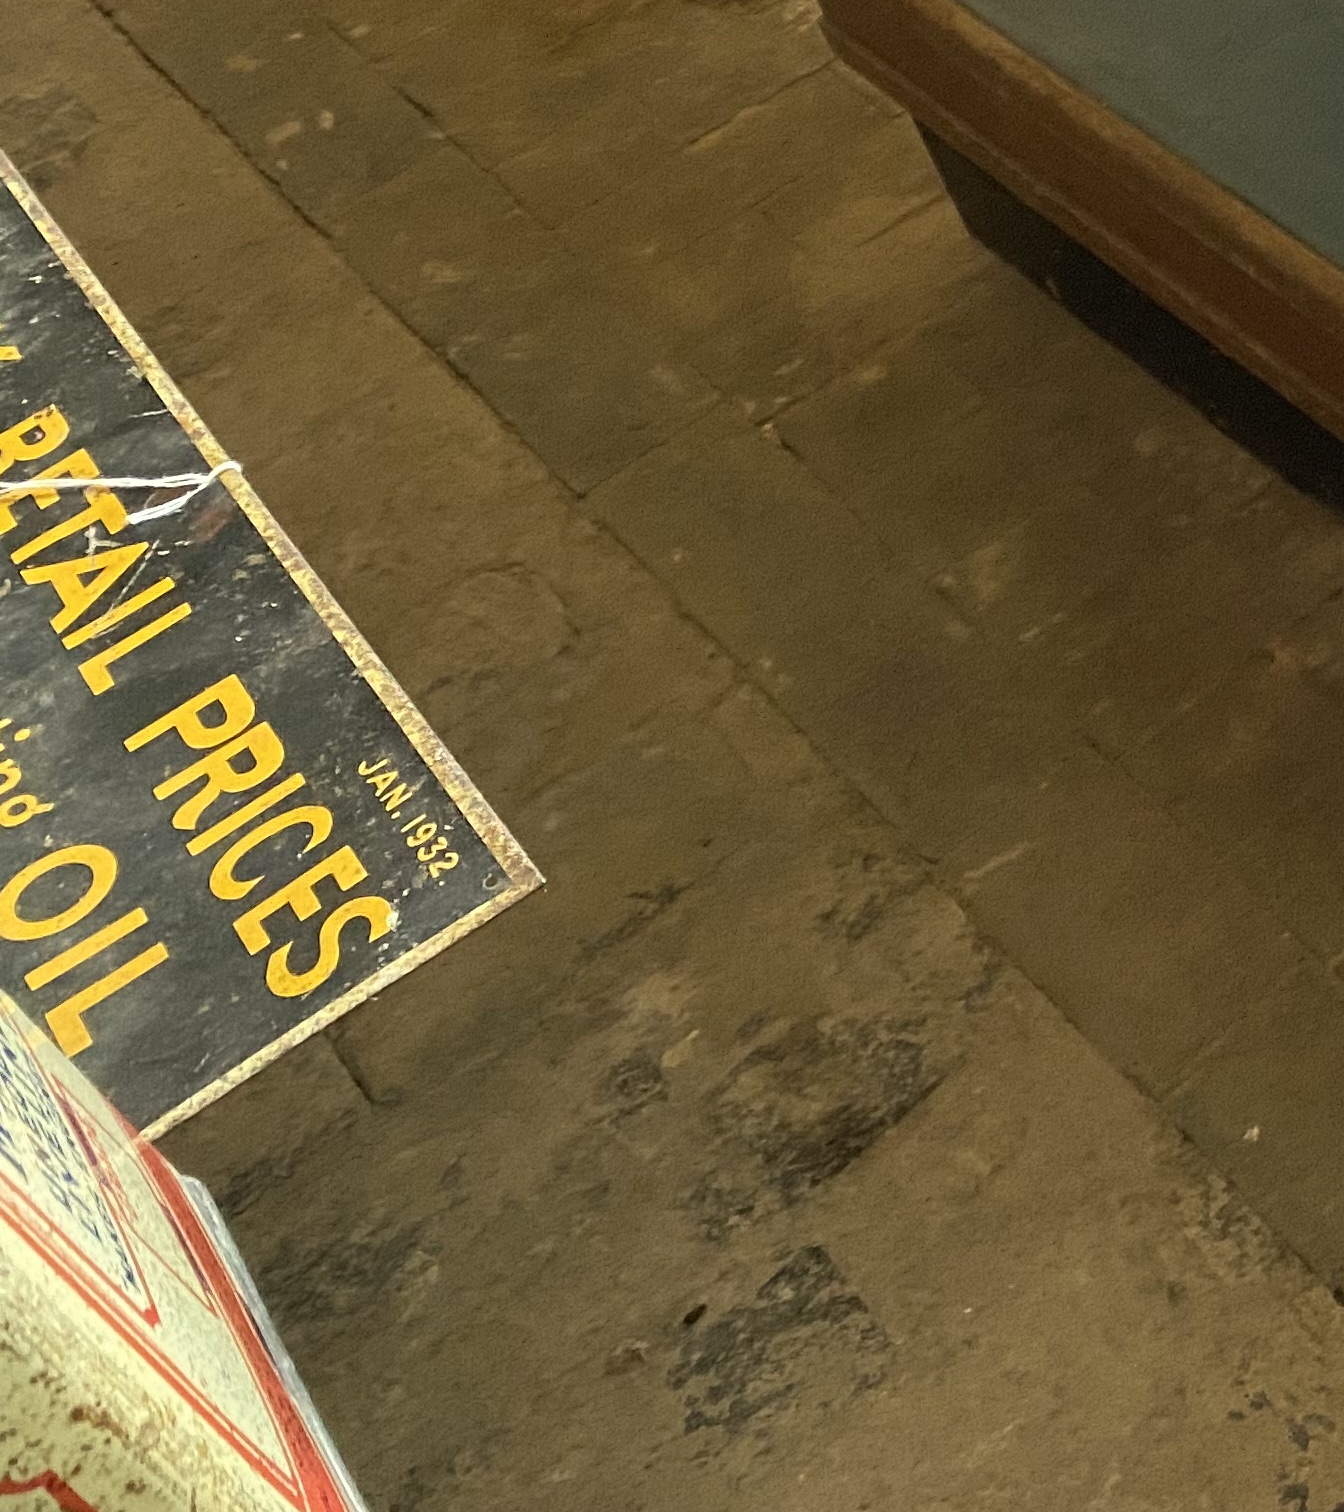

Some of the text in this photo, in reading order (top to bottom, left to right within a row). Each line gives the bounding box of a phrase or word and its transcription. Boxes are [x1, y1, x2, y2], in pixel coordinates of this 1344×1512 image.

[0, 403, 395, 998] RETAIL PRICES
[0, 844, 169, 1058] OIL
